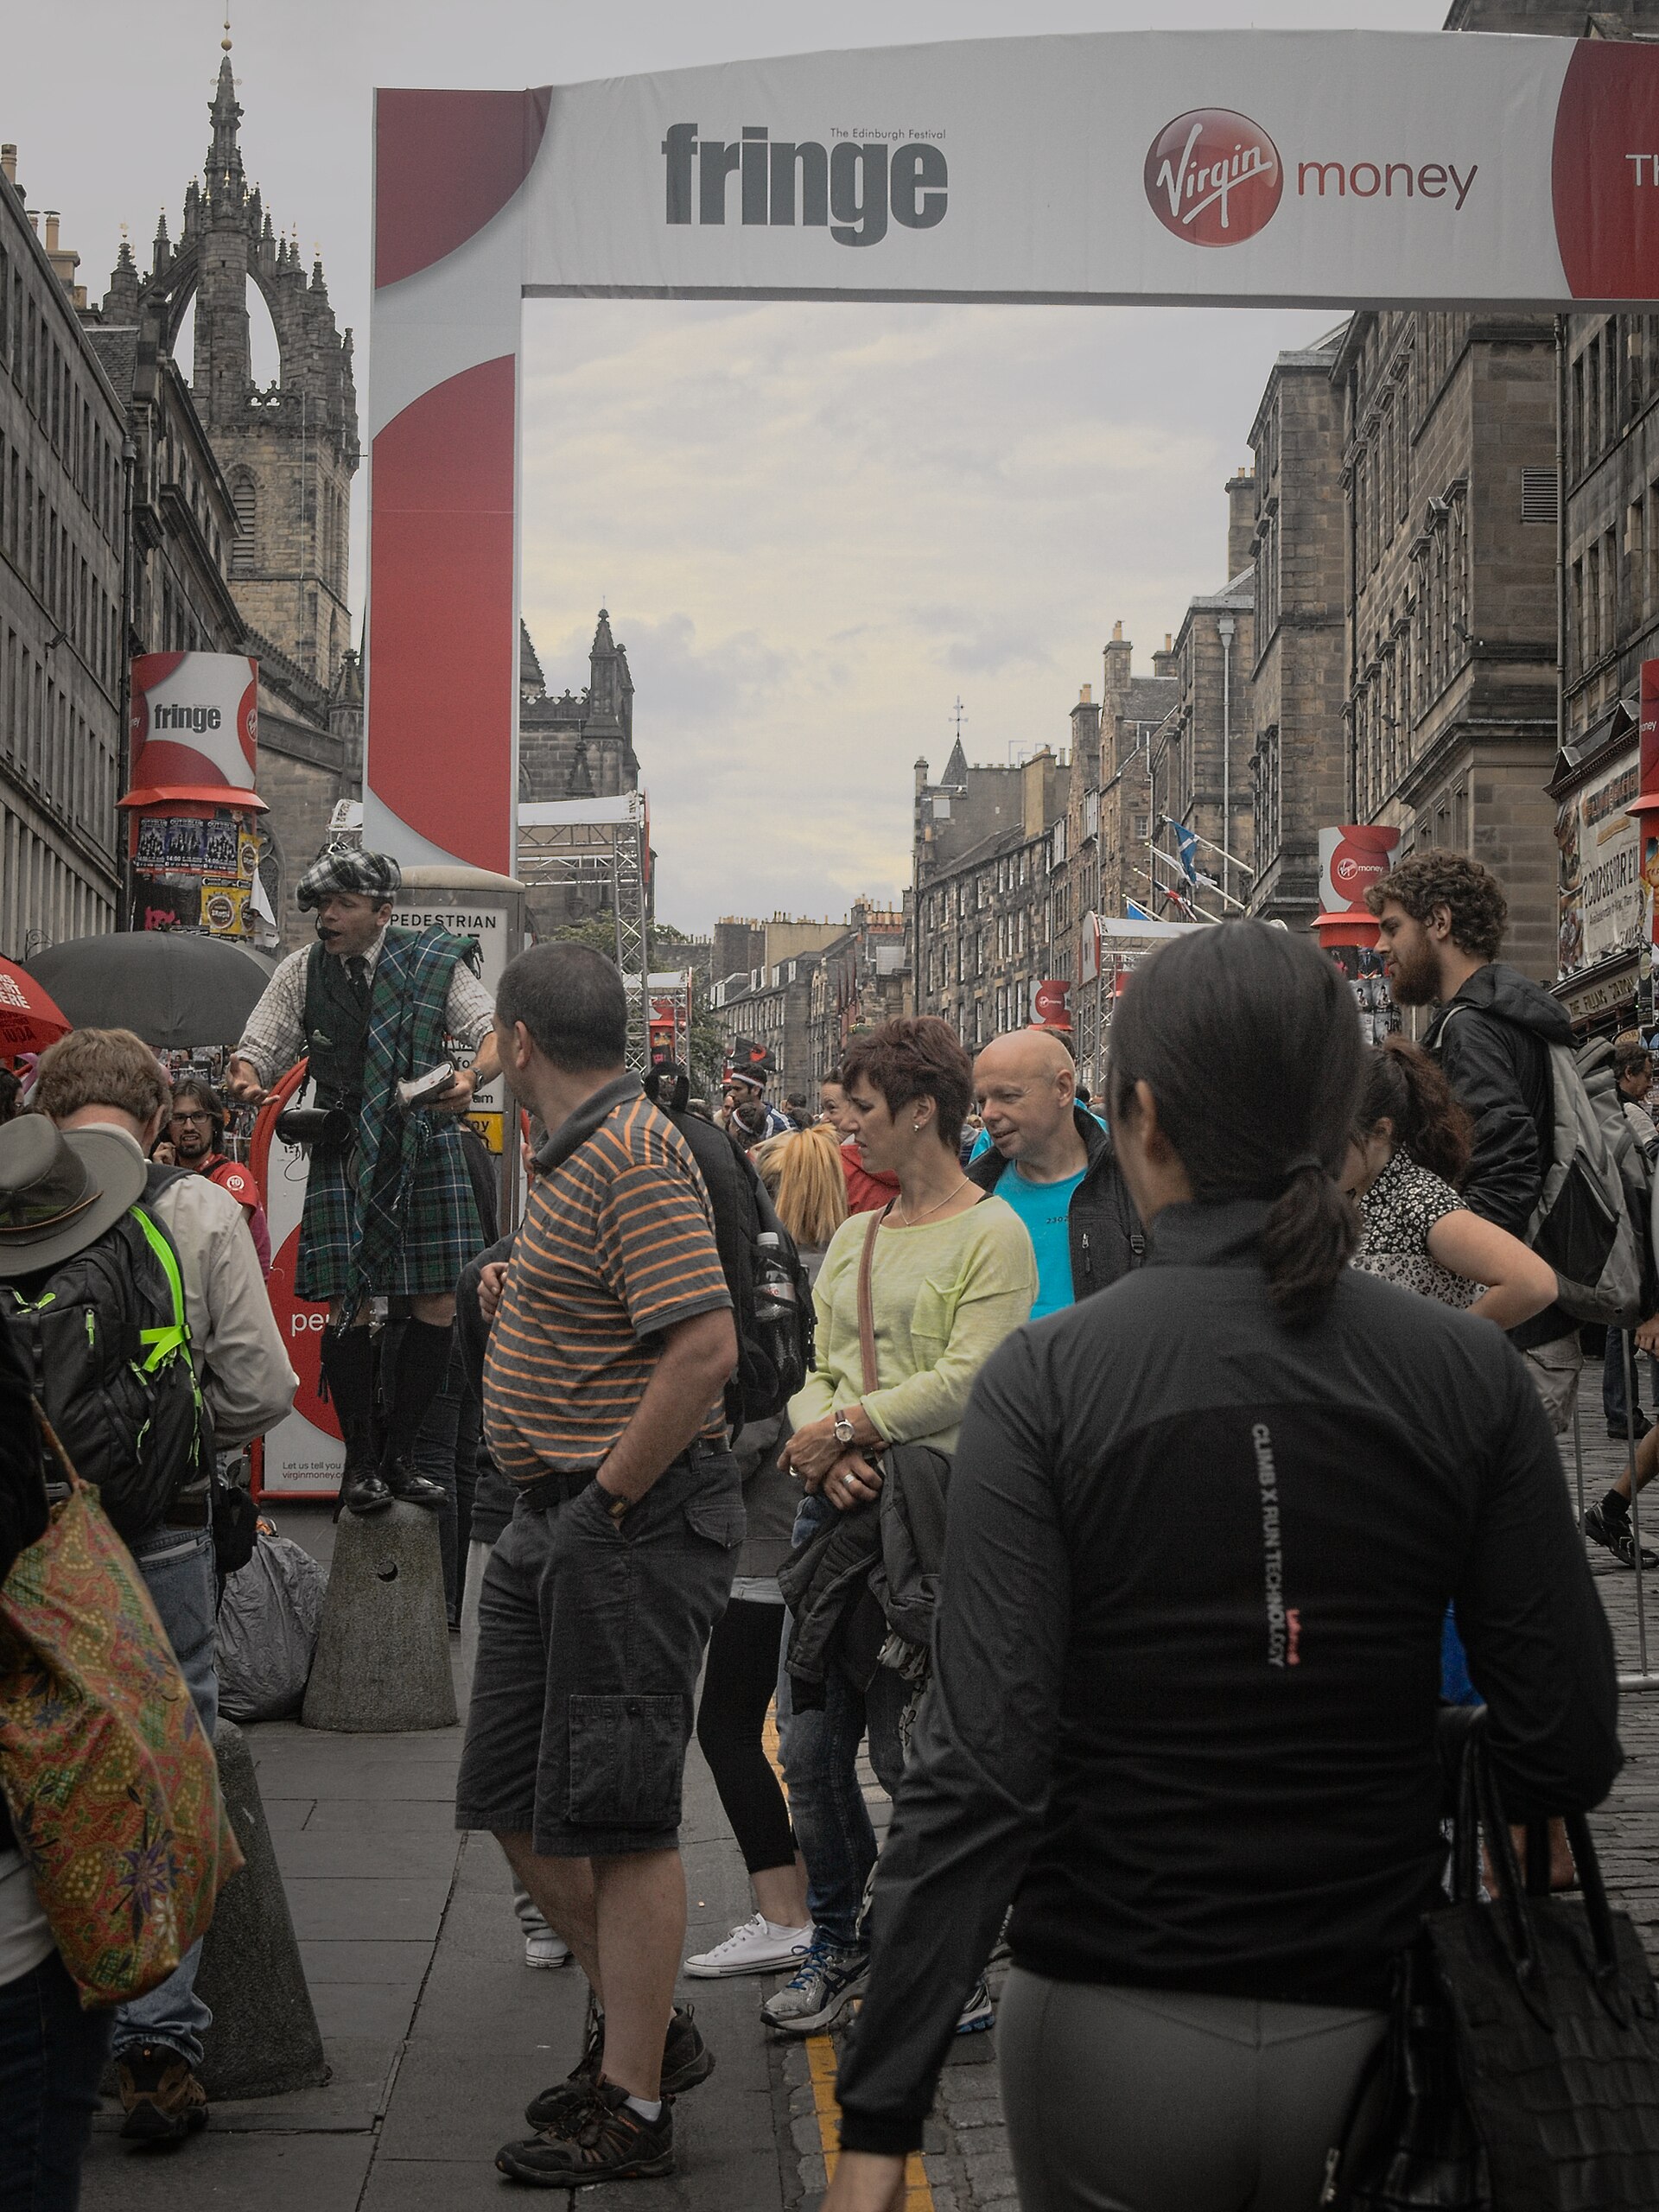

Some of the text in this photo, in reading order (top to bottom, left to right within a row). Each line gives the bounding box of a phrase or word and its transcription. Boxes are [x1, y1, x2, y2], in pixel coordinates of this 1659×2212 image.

[830, 128, 946, 140] The Edinburgh Festival
[661, 123, 948, 247] fringe
[1156, 123, 1273, 228] Virgin
[1298, 162, 1478, 211] money
[155, 703, 221, 734] fringe
[390, 914, 496, 929] PEDESTRIAN
[0, 991, 31, 1009] ERE
[1253, 1424, 1286, 1667] CLIMB X RUN TECHNOLOGY
